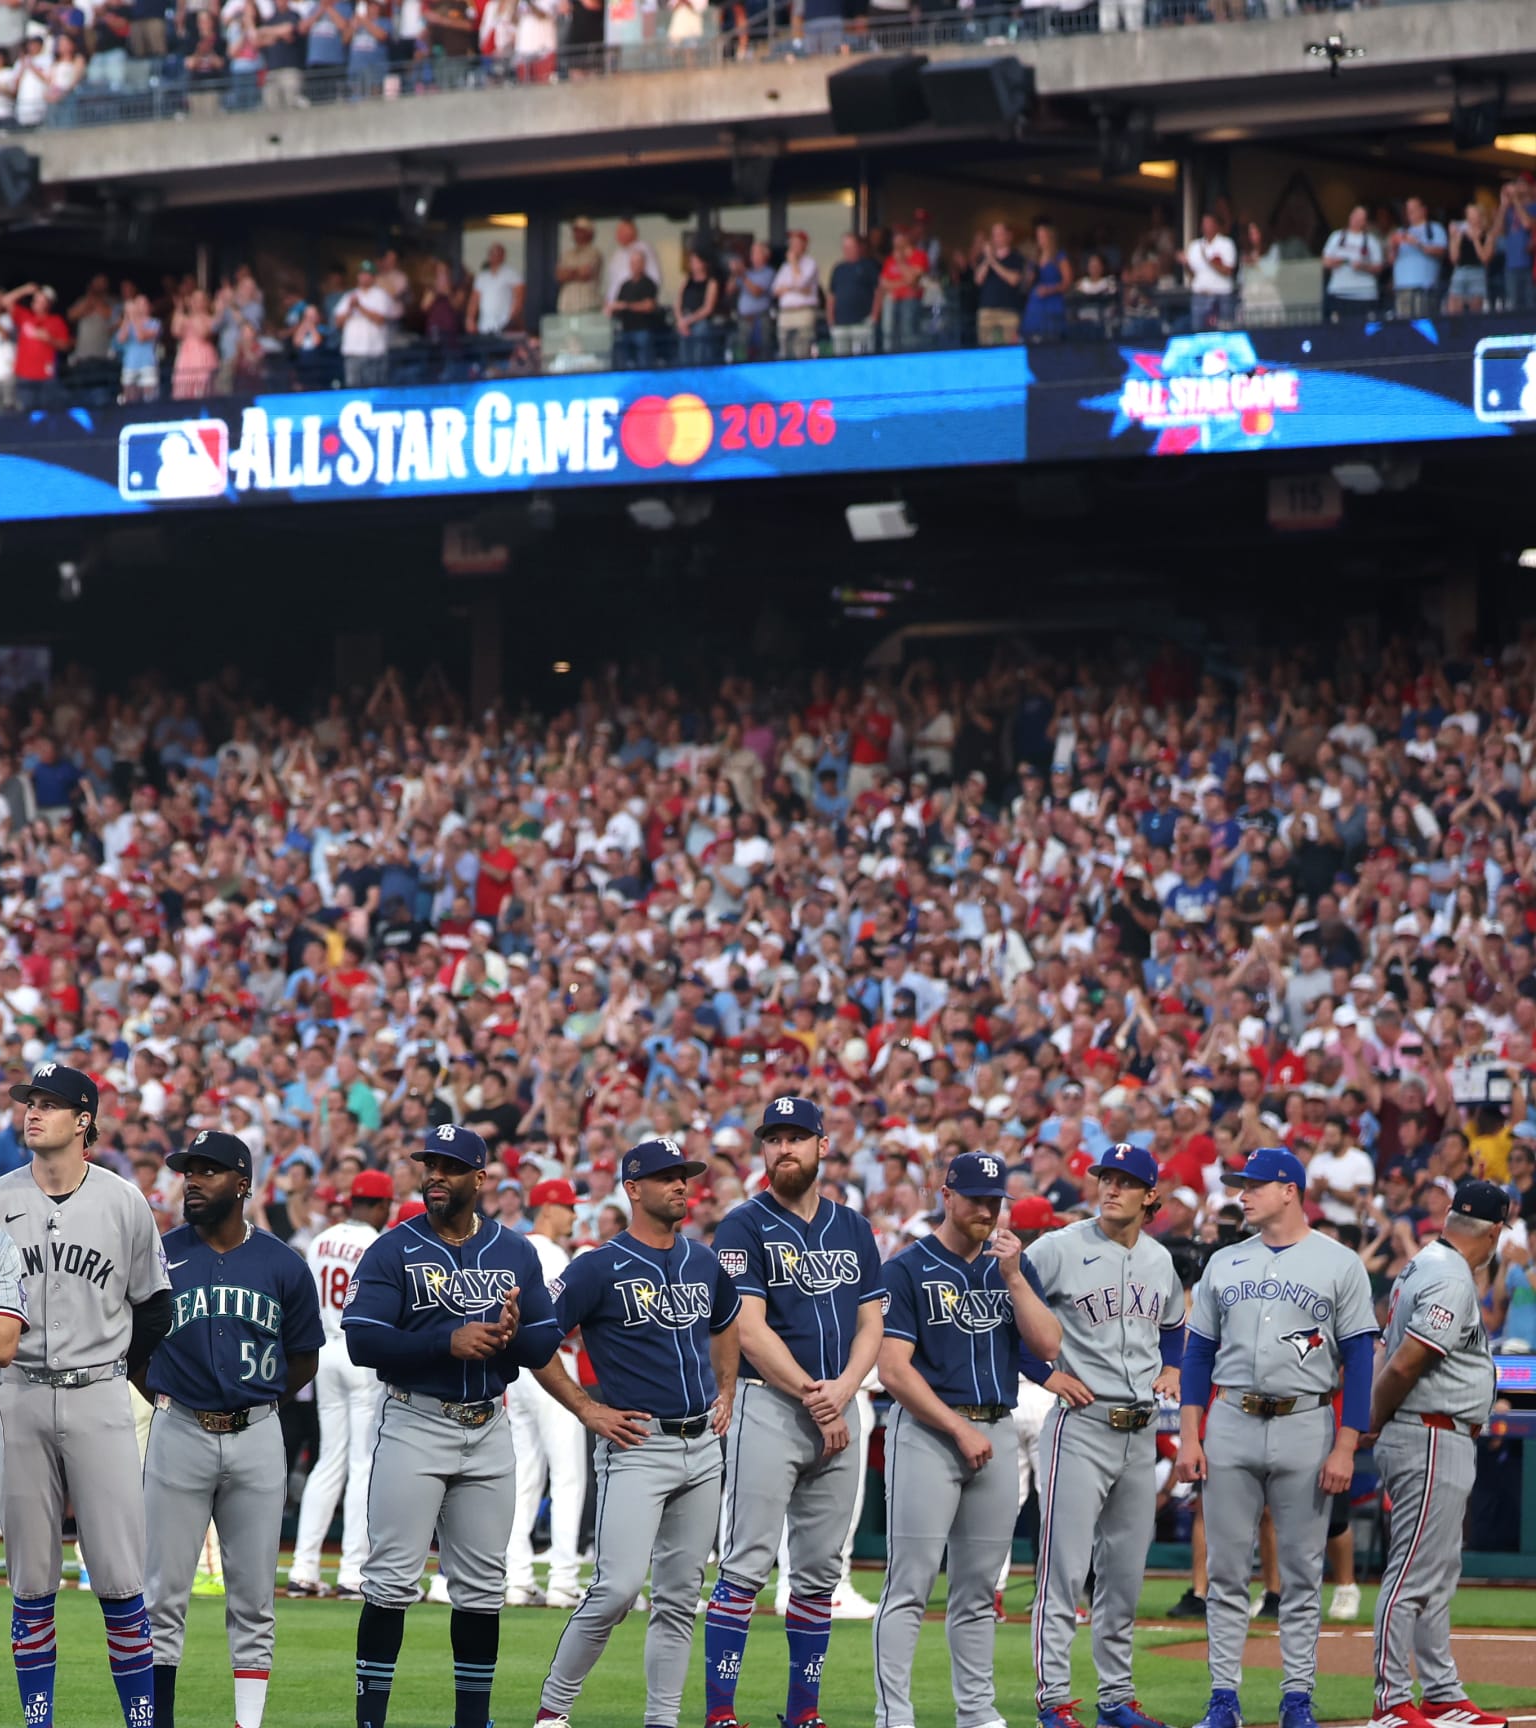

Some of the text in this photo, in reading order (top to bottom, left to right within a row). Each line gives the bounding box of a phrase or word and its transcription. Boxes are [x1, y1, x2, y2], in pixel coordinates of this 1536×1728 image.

[473, 391, 620, 479] GAME
[720, 400, 837, 450] 2026
[775, 1097, 795, 1115] TB
[436, 1123, 456, 1141] TB
[658, 1138, 681, 1156] TB
[1115, 1143, 1131, 1160] T
[979, 1157, 999, 1178] TB
[51, 1242, 114, 1290] YORK
[721, 1252, 743, 1260] USA
[321, 1264, 349, 1309] 18
[1073, 1283, 1161, 1327] TEXA
[1220, 1279, 1332, 1321] ORONTO
[240, 1340, 277, 1382] 56
[804, 1663, 823, 1676] AS
